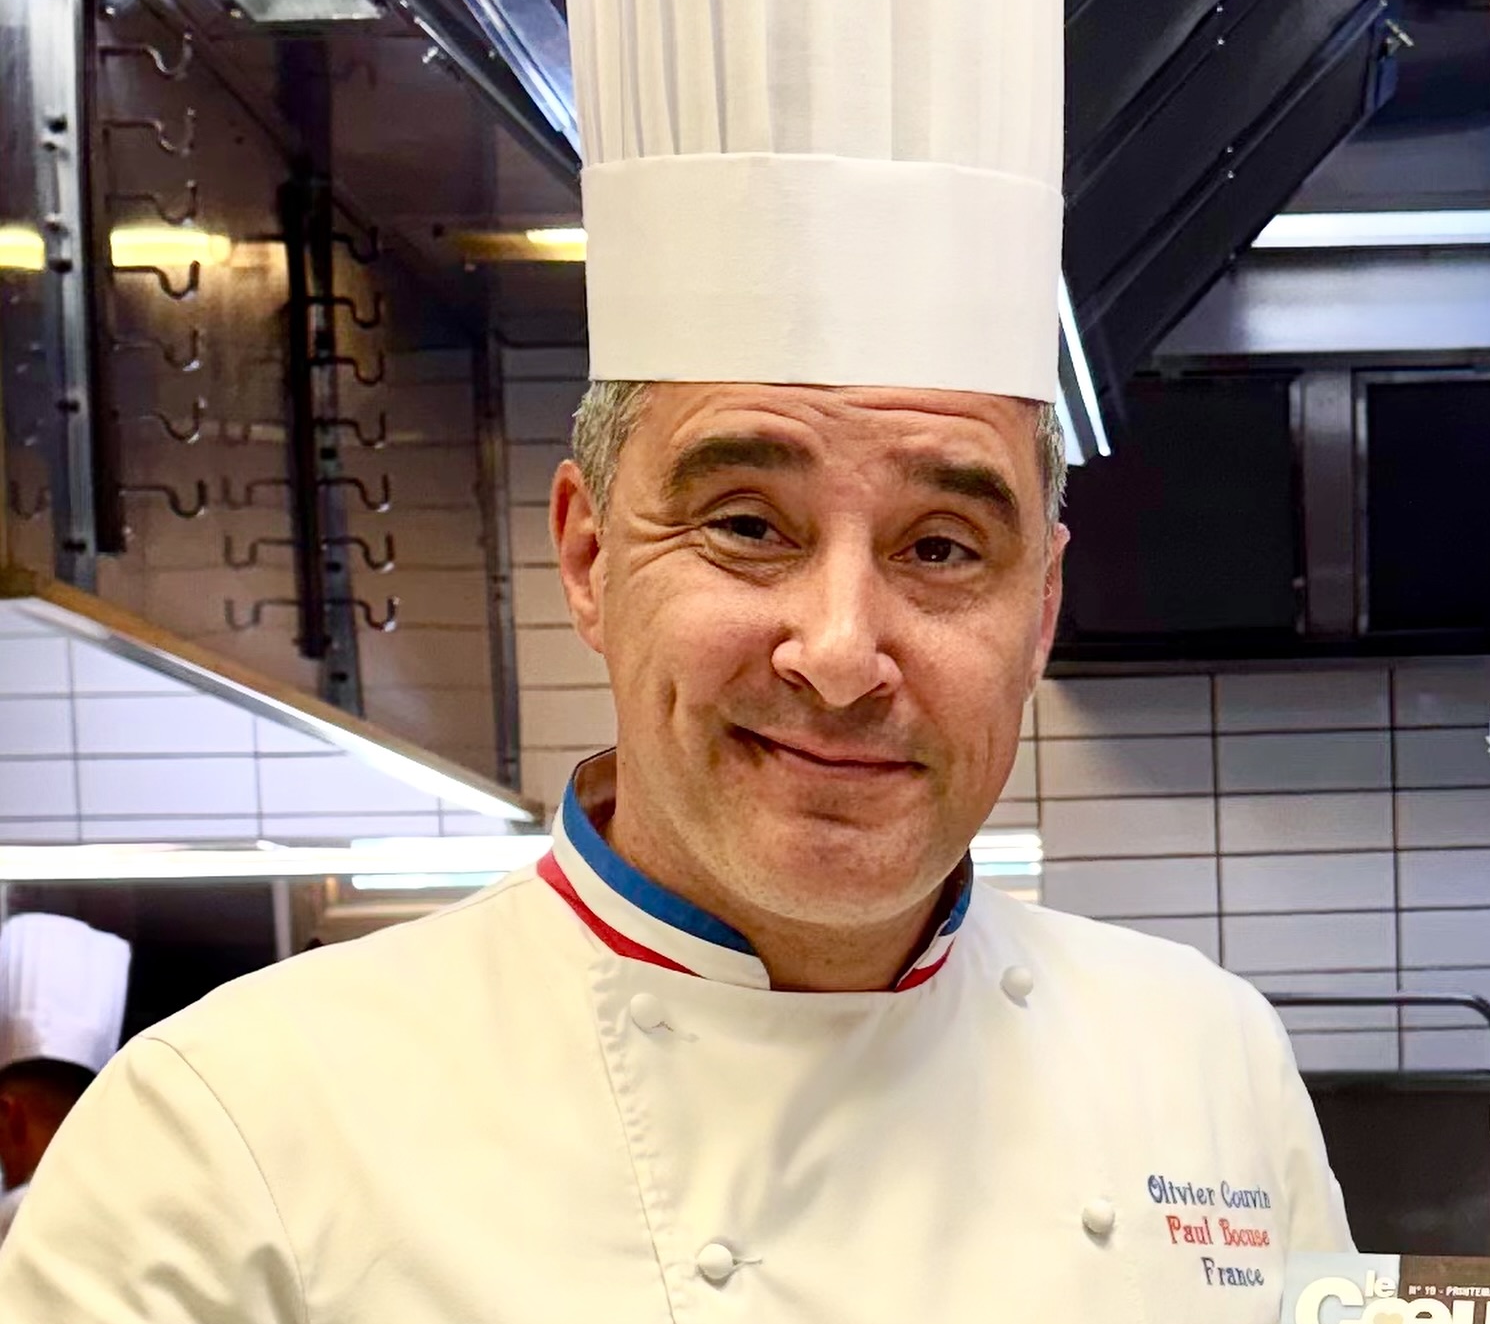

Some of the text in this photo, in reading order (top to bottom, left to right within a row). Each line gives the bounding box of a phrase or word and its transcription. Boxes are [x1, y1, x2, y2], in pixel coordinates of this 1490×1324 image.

[1147, 1174, 1215, 1206] Olivier
[1165, 1215, 1270, 1247] Paul Bocuse
[1201, 1256, 1264, 1286] France
[1365, 1270, 1396, 1298] le
